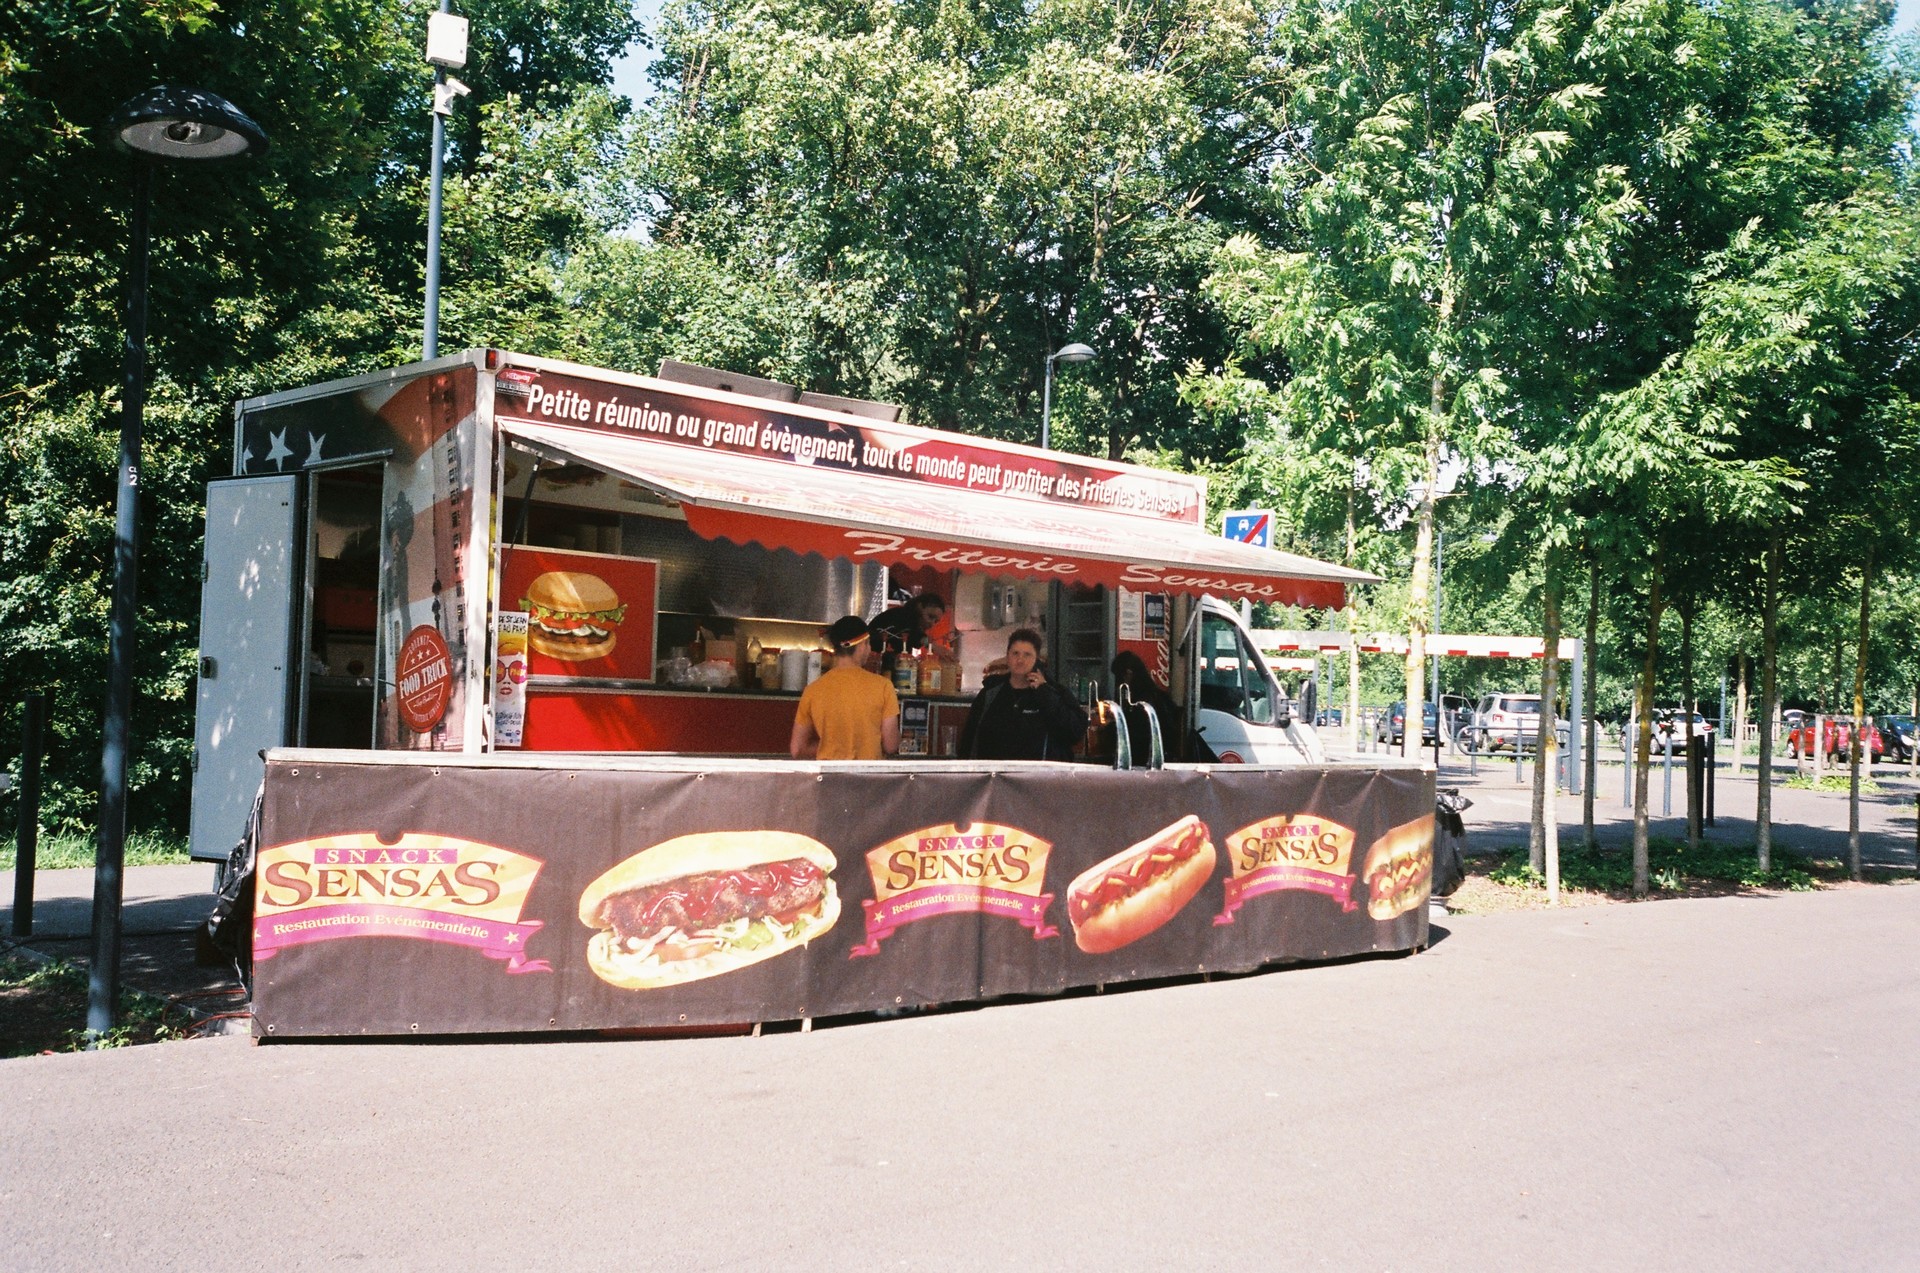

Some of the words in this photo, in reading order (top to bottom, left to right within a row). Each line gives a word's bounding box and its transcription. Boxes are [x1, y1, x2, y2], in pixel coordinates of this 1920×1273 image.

[526, 384, 591, 421] Petite
[594, 397, 672, 434] réunion
[675, 414, 701, 438] ou
[702, 420, 758, 447] grand
[760, 422, 859, 467] évènement,
[862, 441, 895, 469] tout
[898, 449, 913, 472] le
[915, 454, 966, 481] monde
[967, 463, 1001, 487] peut
[1002, 467, 1056, 494] profiter
[1057, 473, 1081, 499] des
[1082, 477, 1135, 508] Friteries
[1136, 489, 1178, 513] Sensas
[129, 474, 138, 486] 2
[844, 531, 1079, 574] Friterie
[1120, 564, 1281, 596] Sensas
[399, 672, 420, 699] FOOD
[421, 657, 448, 687] TRUCK
[924, 835, 997, 851] SNACK
[1265, 825, 1314, 838] SNACK
[325, 849, 447, 864] SNACK
[886, 844, 1031, 890] SENSAS
[1240, 832, 1339, 870] SENSAS
[262, 860, 501, 907] SENSAS
[892, 894, 955, 915] Restauration
[273, 913, 370, 935] Restauration
[374, 914, 489, 939] Evénementielle
